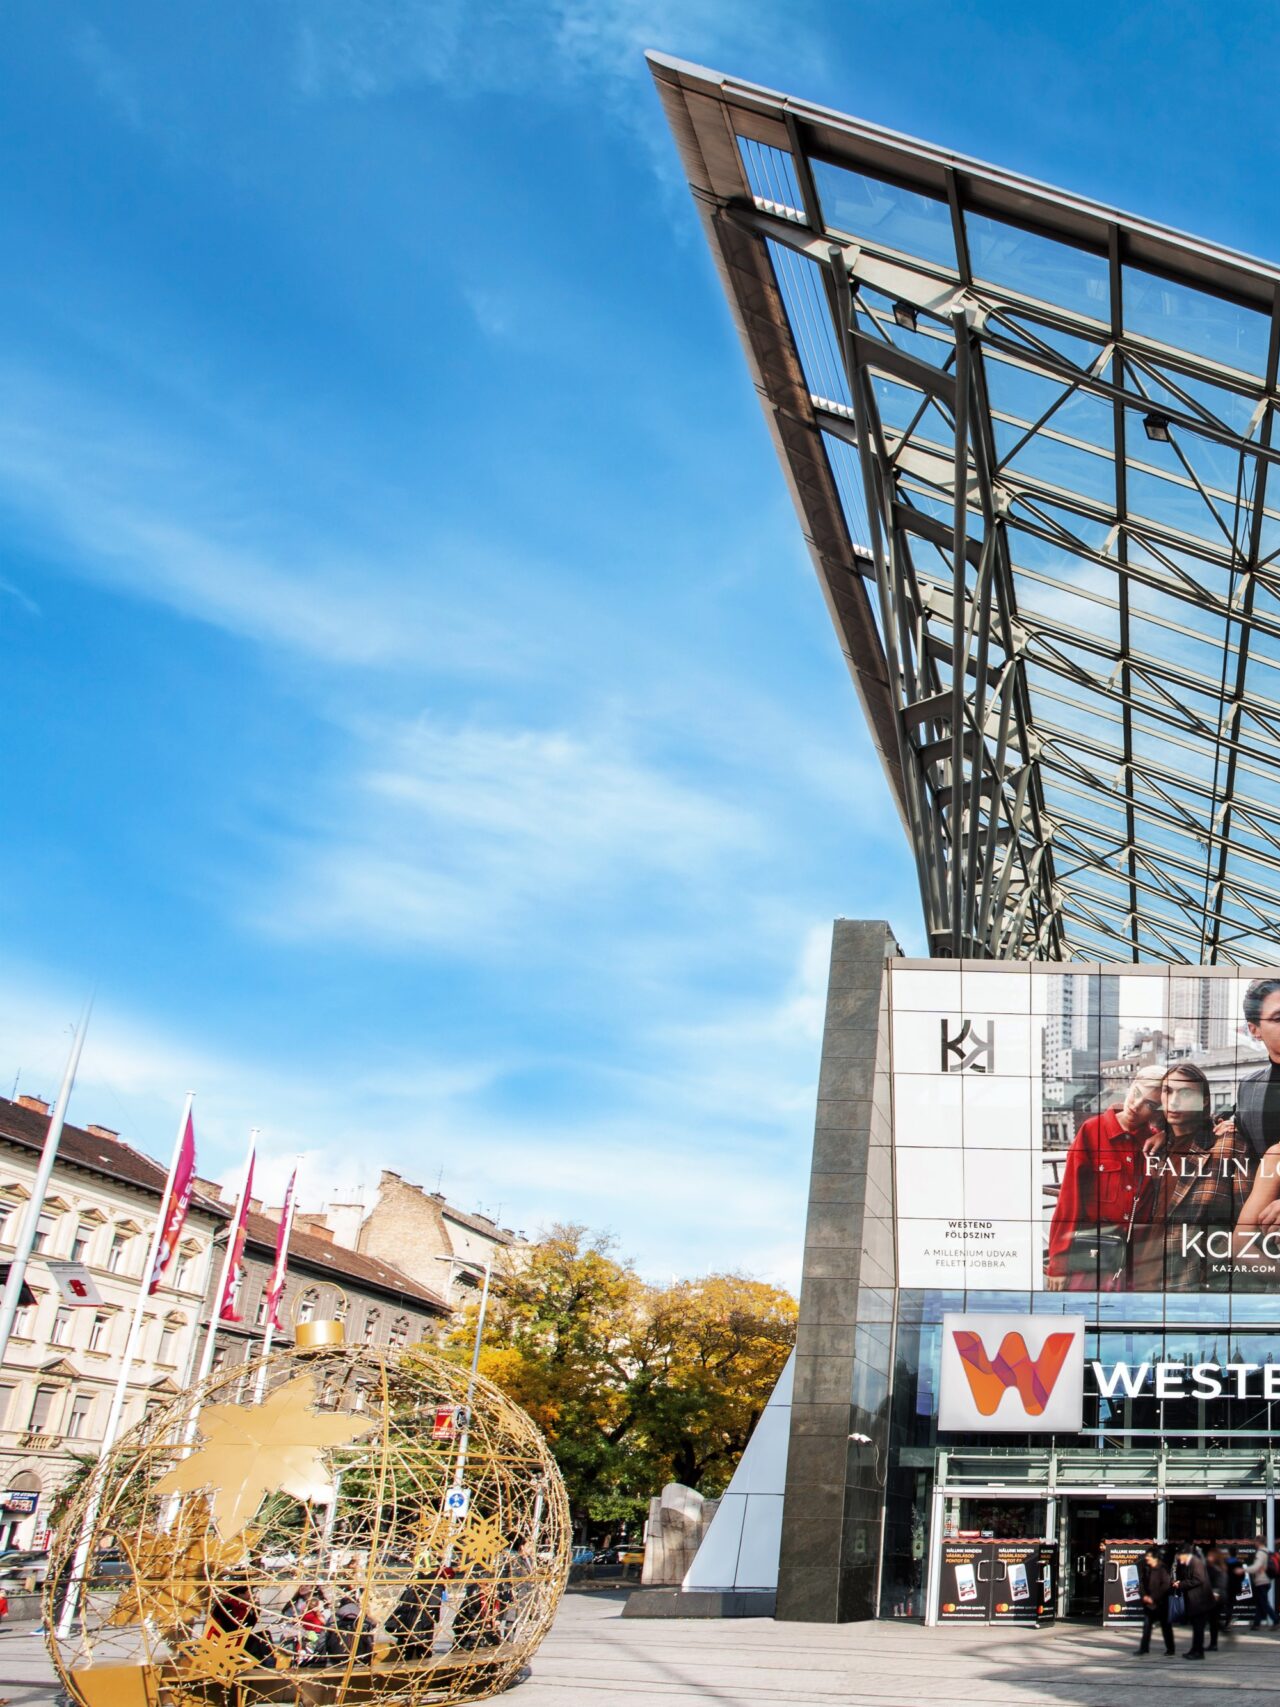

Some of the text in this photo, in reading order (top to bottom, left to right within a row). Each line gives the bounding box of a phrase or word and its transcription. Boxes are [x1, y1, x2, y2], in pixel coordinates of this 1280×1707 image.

[1144, 1156, 1212, 1178] FALL
[1221, 1157, 1250, 1178] IN
[948, 1221, 993, 1229] WESTEND
[945, 1231, 996, 1239] FÖLDSZINT
[933, 1249, 983, 1257] MILLENIUM
[986, 1250, 1018, 1258] UDVAR
[935, 1259, 1006, 1268] FELETT JOBBRA
[1212, 1264, 1276, 1273] KAZAR.COM
[952, 1330, 1076, 1416] W
